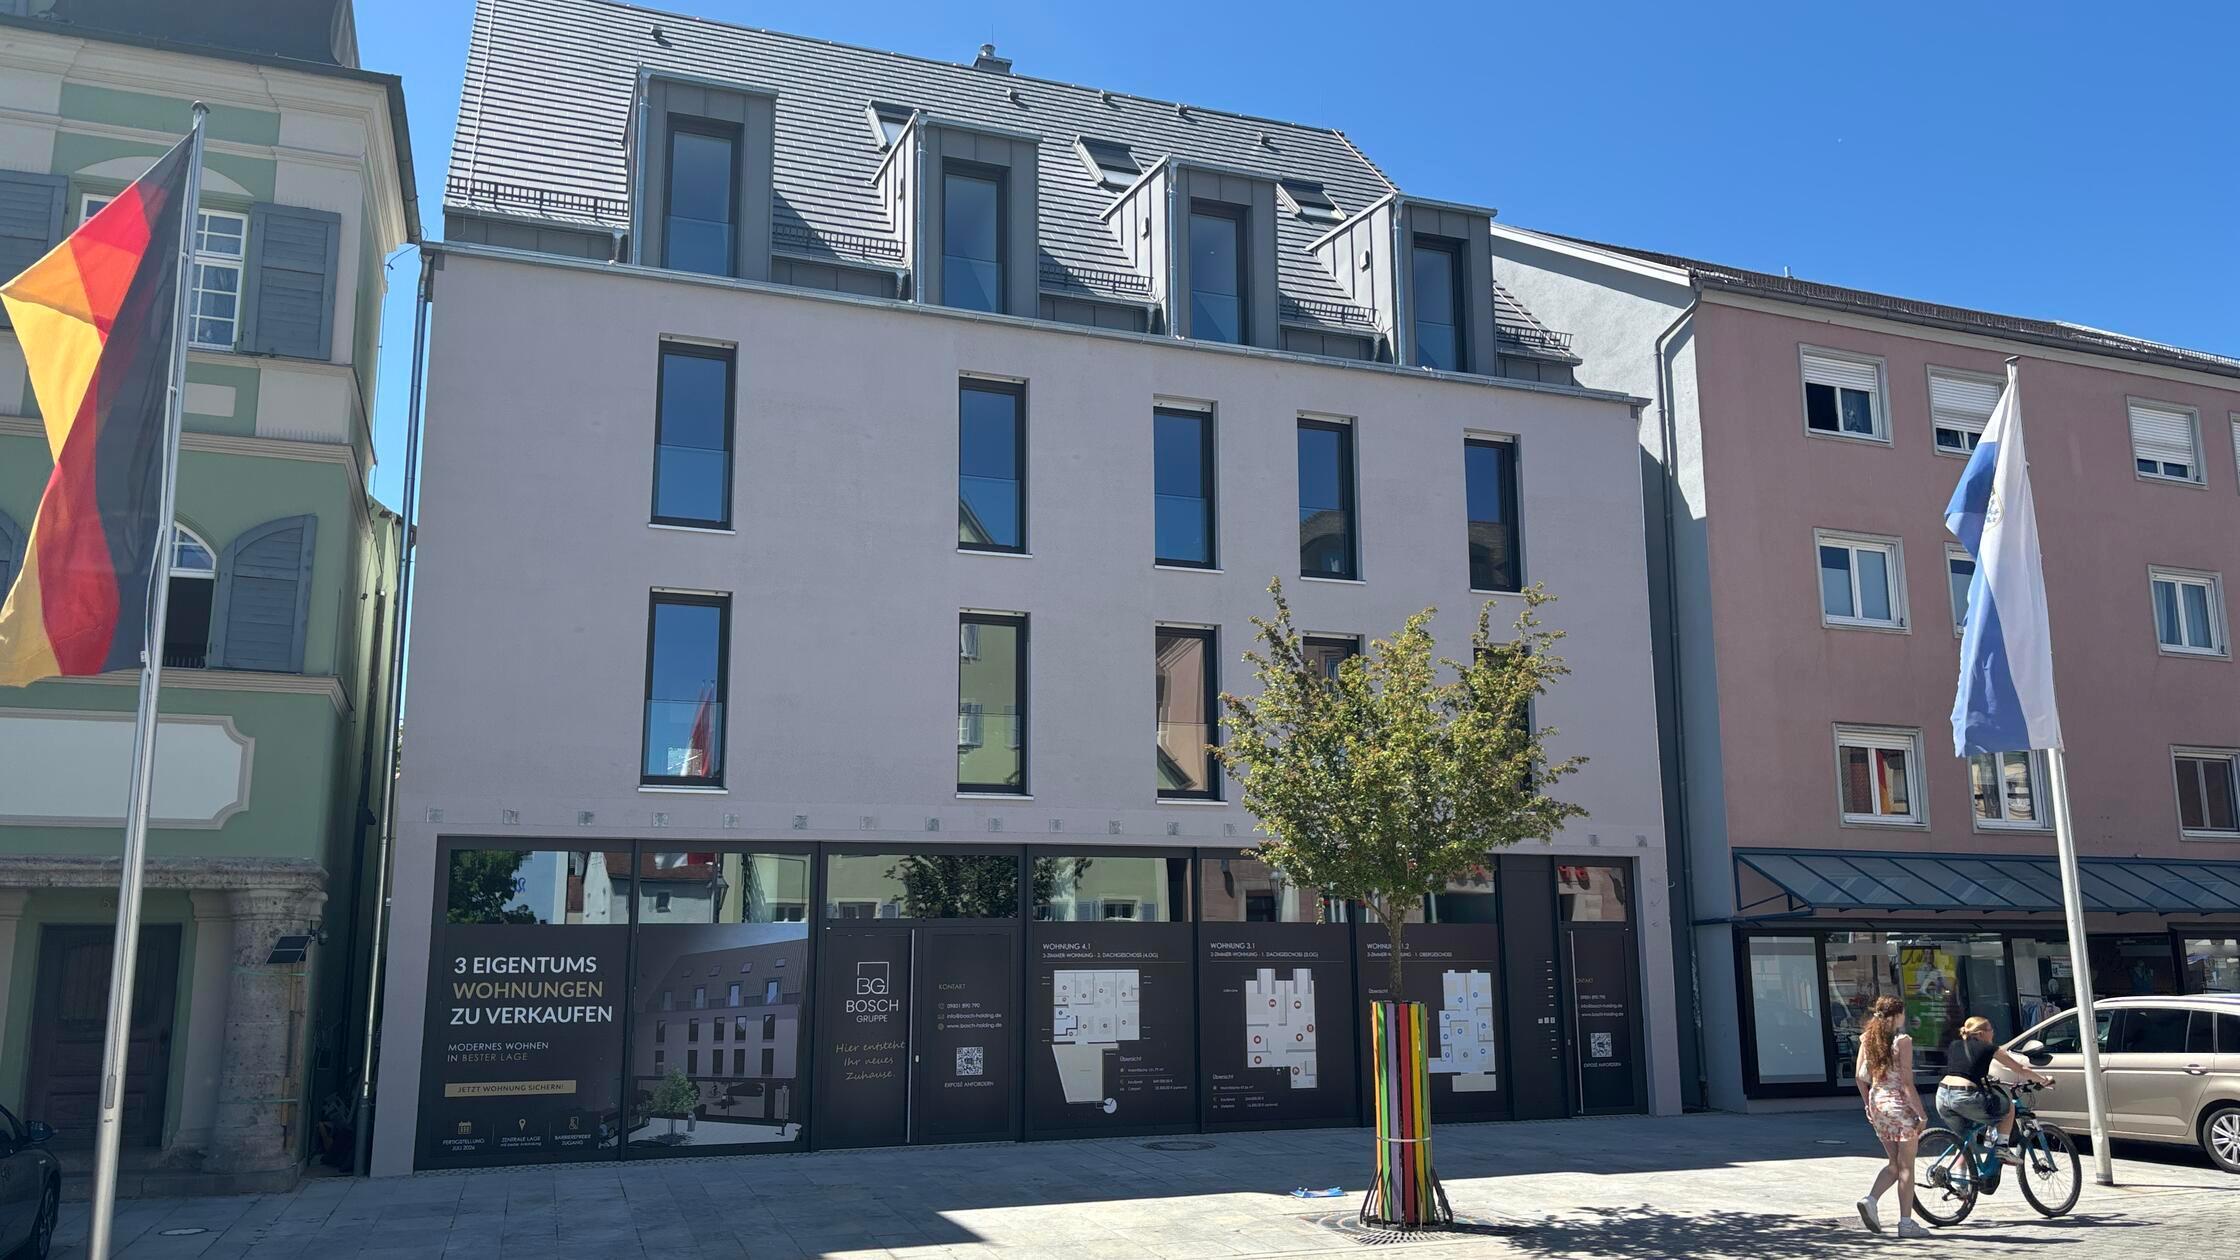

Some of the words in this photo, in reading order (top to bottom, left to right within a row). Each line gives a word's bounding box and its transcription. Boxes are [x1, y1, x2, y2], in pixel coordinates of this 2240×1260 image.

[454, 957, 467, 974] 3
[473, 956, 597, 974] EIGENTUMS
[453, 981, 603, 999] WOHNUNGEN
[856, 977, 889, 994] BG
[846, 999, 899, 1013] BOSCH
[450, 1008, 481, 1025] ZU
[486, 1006, 613, 1024] VERKAUFEN
[856, 1014, 888, 1023] GRUPPE
[448, 1042, 502, 1051] MODERNES
[505, 1041, 549, 1050] WOHNEN
[835, 1043, 860, 1053] Hier
[863, 1040, 906, 1051] entsteht
[447, 1054, 458, 1062] IN
[462, 1053, 496, 1062] BESTER
[500, 1053, 528, 1061] LAGE
[844, 1057, 861, 1067] Ihr
[865, 1057, 894, 1065] neues
[457, 1085, 481, 1093] JETZT
